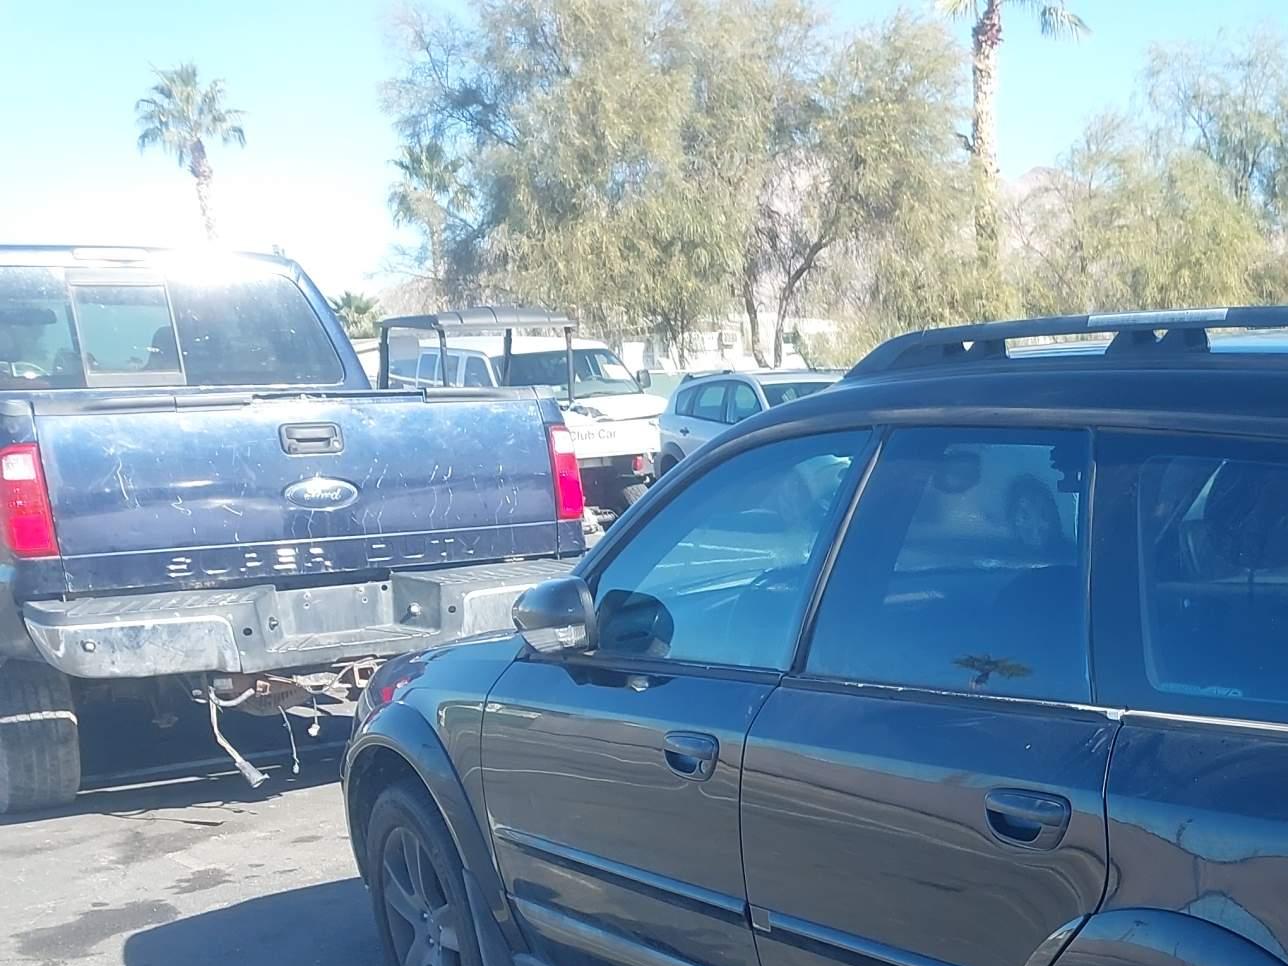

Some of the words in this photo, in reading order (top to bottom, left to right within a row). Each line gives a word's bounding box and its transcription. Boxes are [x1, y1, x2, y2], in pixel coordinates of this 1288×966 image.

[569, 431, 595, 441] Club
[598, 429, 616, 440] Car
[166, 547, 334, 578] SUPER
[366, 535, 482, 562] DUTY
